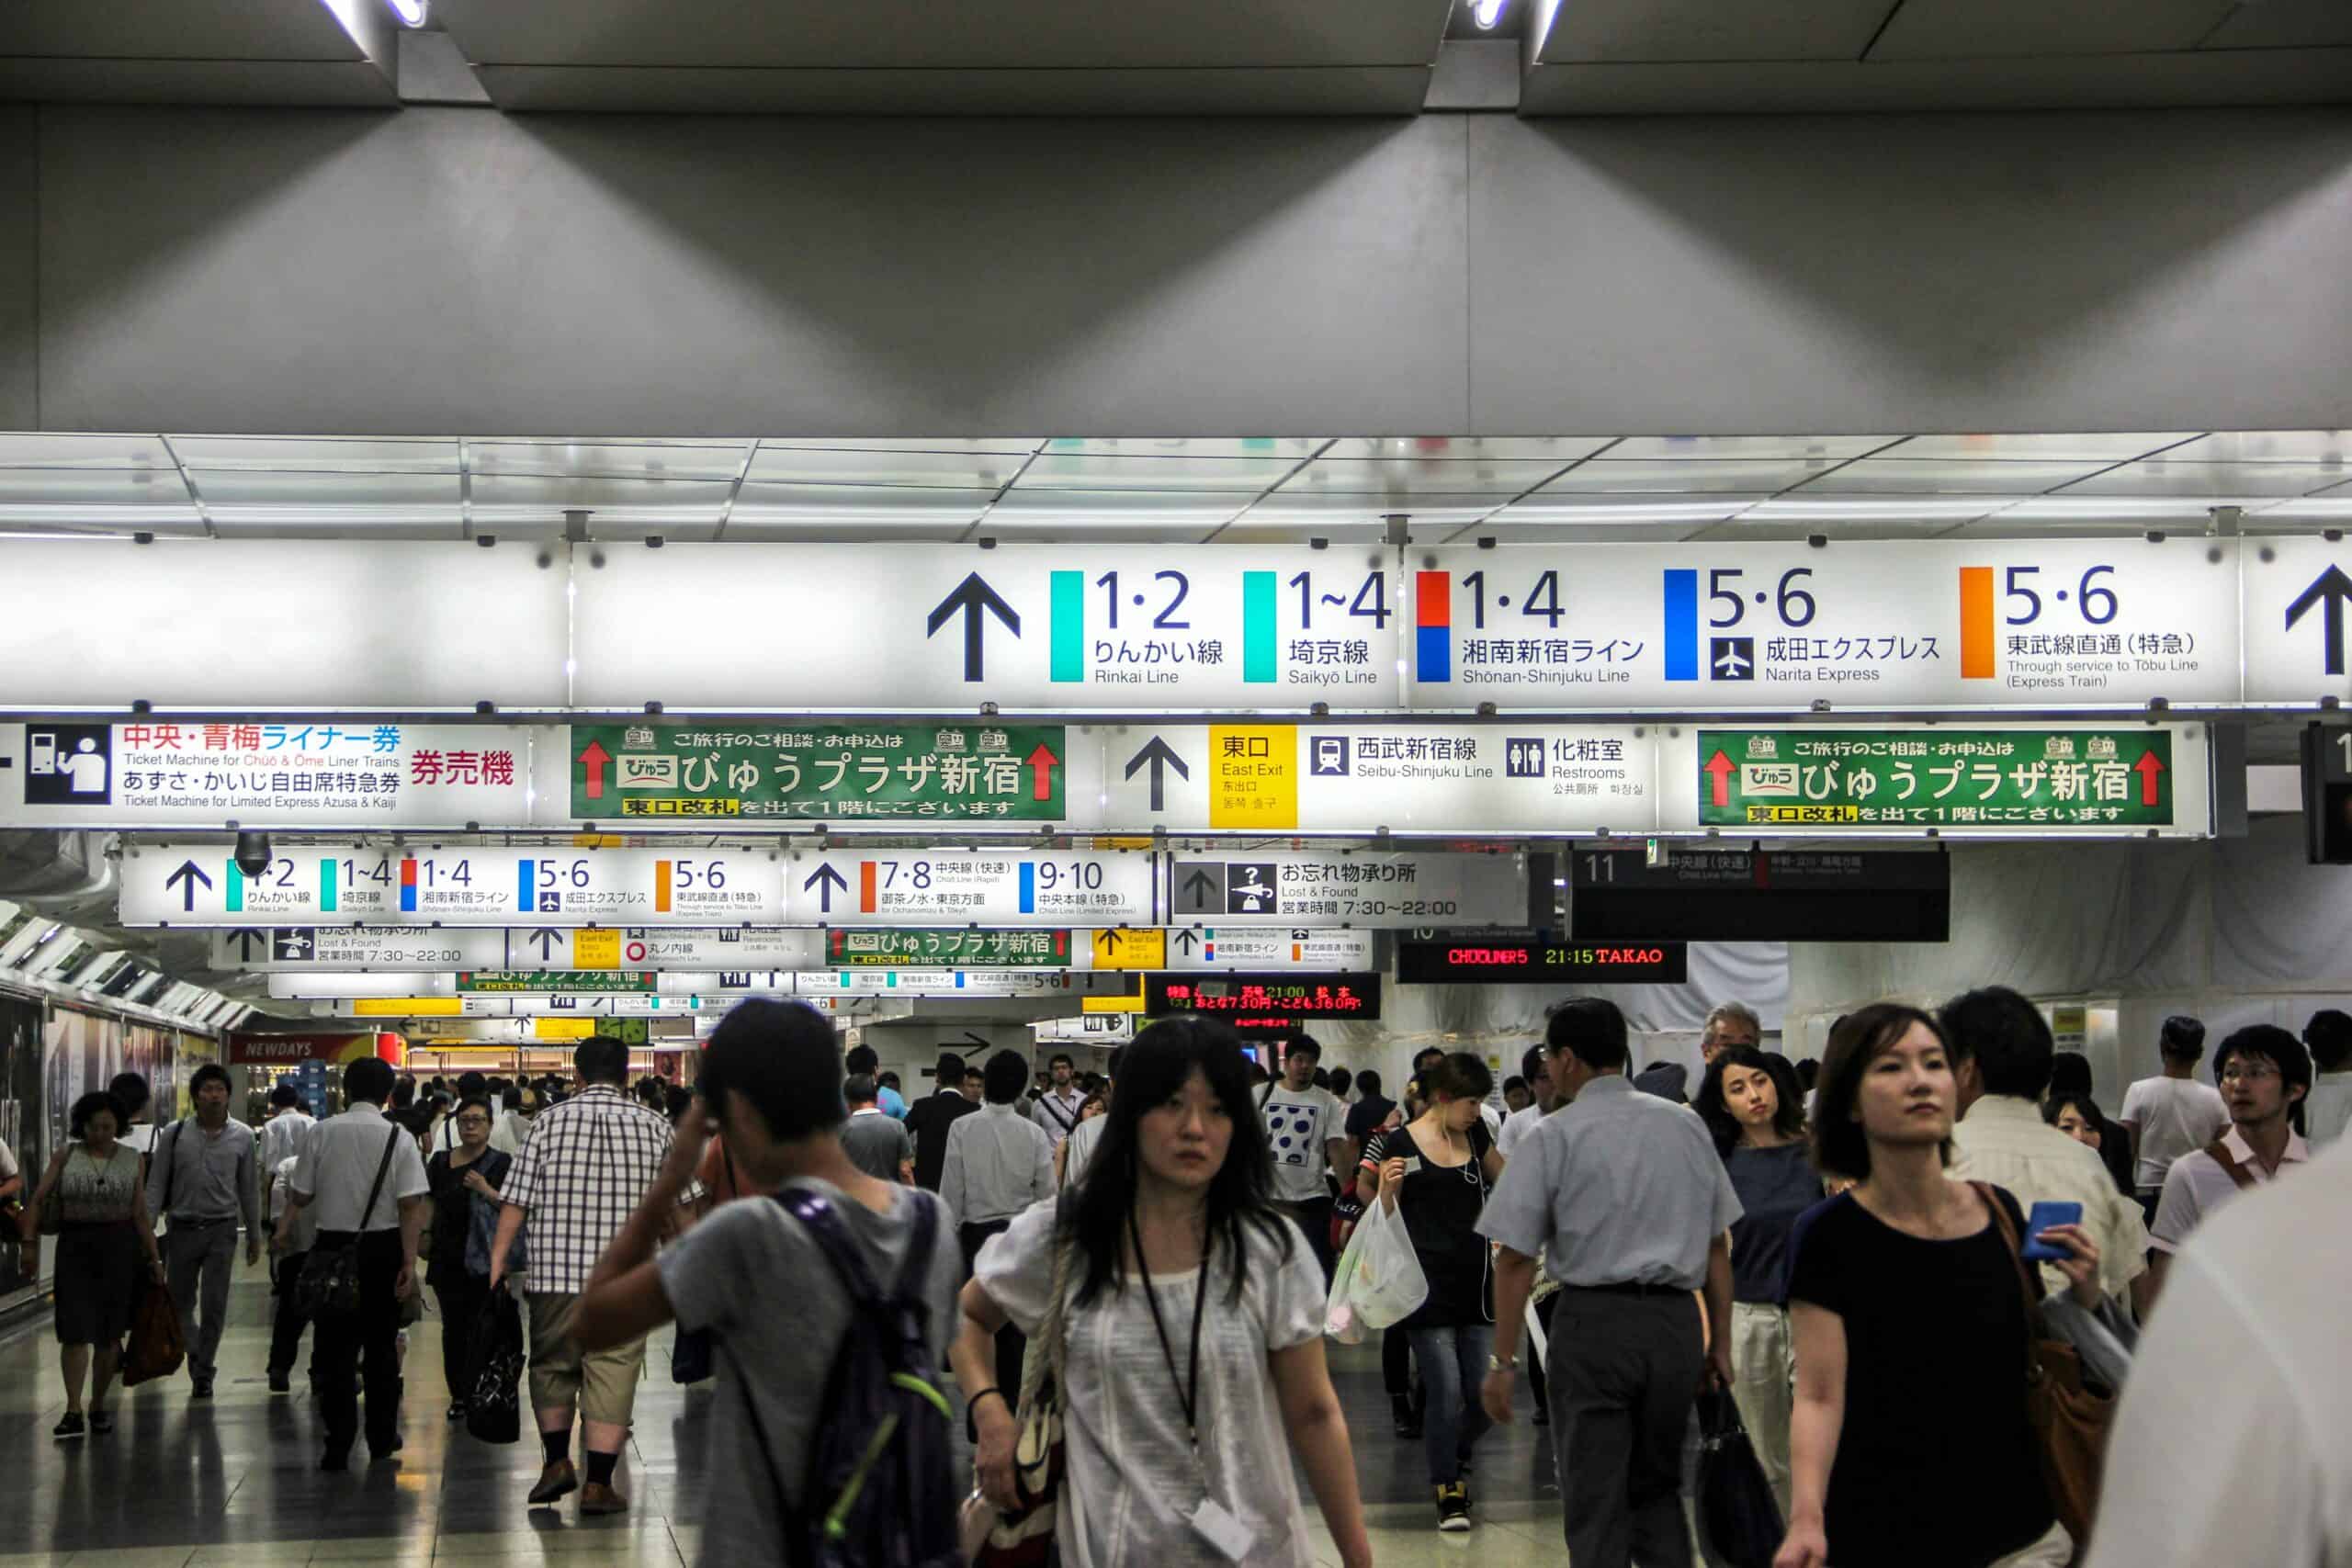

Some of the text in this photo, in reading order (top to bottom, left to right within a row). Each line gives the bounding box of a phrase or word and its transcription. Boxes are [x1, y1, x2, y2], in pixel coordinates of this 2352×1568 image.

[1096, 639, 1222, 664] りんかい線
[1290, 639, 1368, 664] 埼京線
[1463, 639, 1643, 664] 湘南新宿ライン
[1767, 636, 1939, 661] 成田エクスプレス
[1767, 668, 1879, 683] Narita Express
[2008, 660, 2062, 676] Through
[2067, 660, 2112, 671] service
[2118, 661, 2129, 671] to
[2171, 660, 2198, 671] Line
[1096, 670, 1179, 682] Rinkai Line
[1289, 670, 1376, 686] Saikyō Line
[1464, 669, 1630, 685] Shōnan-Shinjuku Line
[2007, 675, 2107, 690] (Express Train)
[1223, 736, 1268, 758] 東口
[1358, 738, 1476, 760] 西武新宿線
[1554, 739, 1623, 761] 化粧室
[125, 753, 162, 764] Ticket
[166, 754, 219, 766] Machine
[223, 755, 239, 766] for
[281, 755, 289, 766] &
[329, 756, 358, 767] Liner
[365, 756, 400, 767] Trains
[412, 750, 514, 784] 券売機
[623, 758, 673, 777] びゅう
[683, 750, 1022, 794] びゅうプラザ新宿
[1221, 762, 1282, 777] East Exit
[1358, 764, 1492, 780] Seibu-Shinjuku Line
[1553, 766, 1624, 779] Restrooms
[1749, 768, 1792, 784] びゅう
[1803, 760, 2130, 801] びゅうプラザ新宿
[125, 795, 396, 810] Ticket Machine for Limited Express Azusa & Kaiji
[1280, 862, 1419, 884] お忘れ物承り所
[1586, 855, 1614, 882] 11
[248, 892, 310, 903] りんかい線
[343, 891, 380, 904] 埼京線
[423, 892, 508, 904] 湘南新宿ライン
[566, 892, 646, 904] 成田エクスプレス
[1283, 886, 1358, 897] Lost & Found
[1283, 901, 1338, 915] 営業時間
[318, 939, 381, 947] Lost & Found
[648, 943, 692, 953] 丸ノ内線
[881, 932, 1050, 953] びゅうプラザ新宿
[318, 950, 365, 961] 営業時間
[1545, 949, 1594, 964] 21:15
[1596, 949, 1663, 964] TAKAO
[1267, 987, 1305, 998] 21:00
[245, 1043, 312, 1057] NEWDAYS
